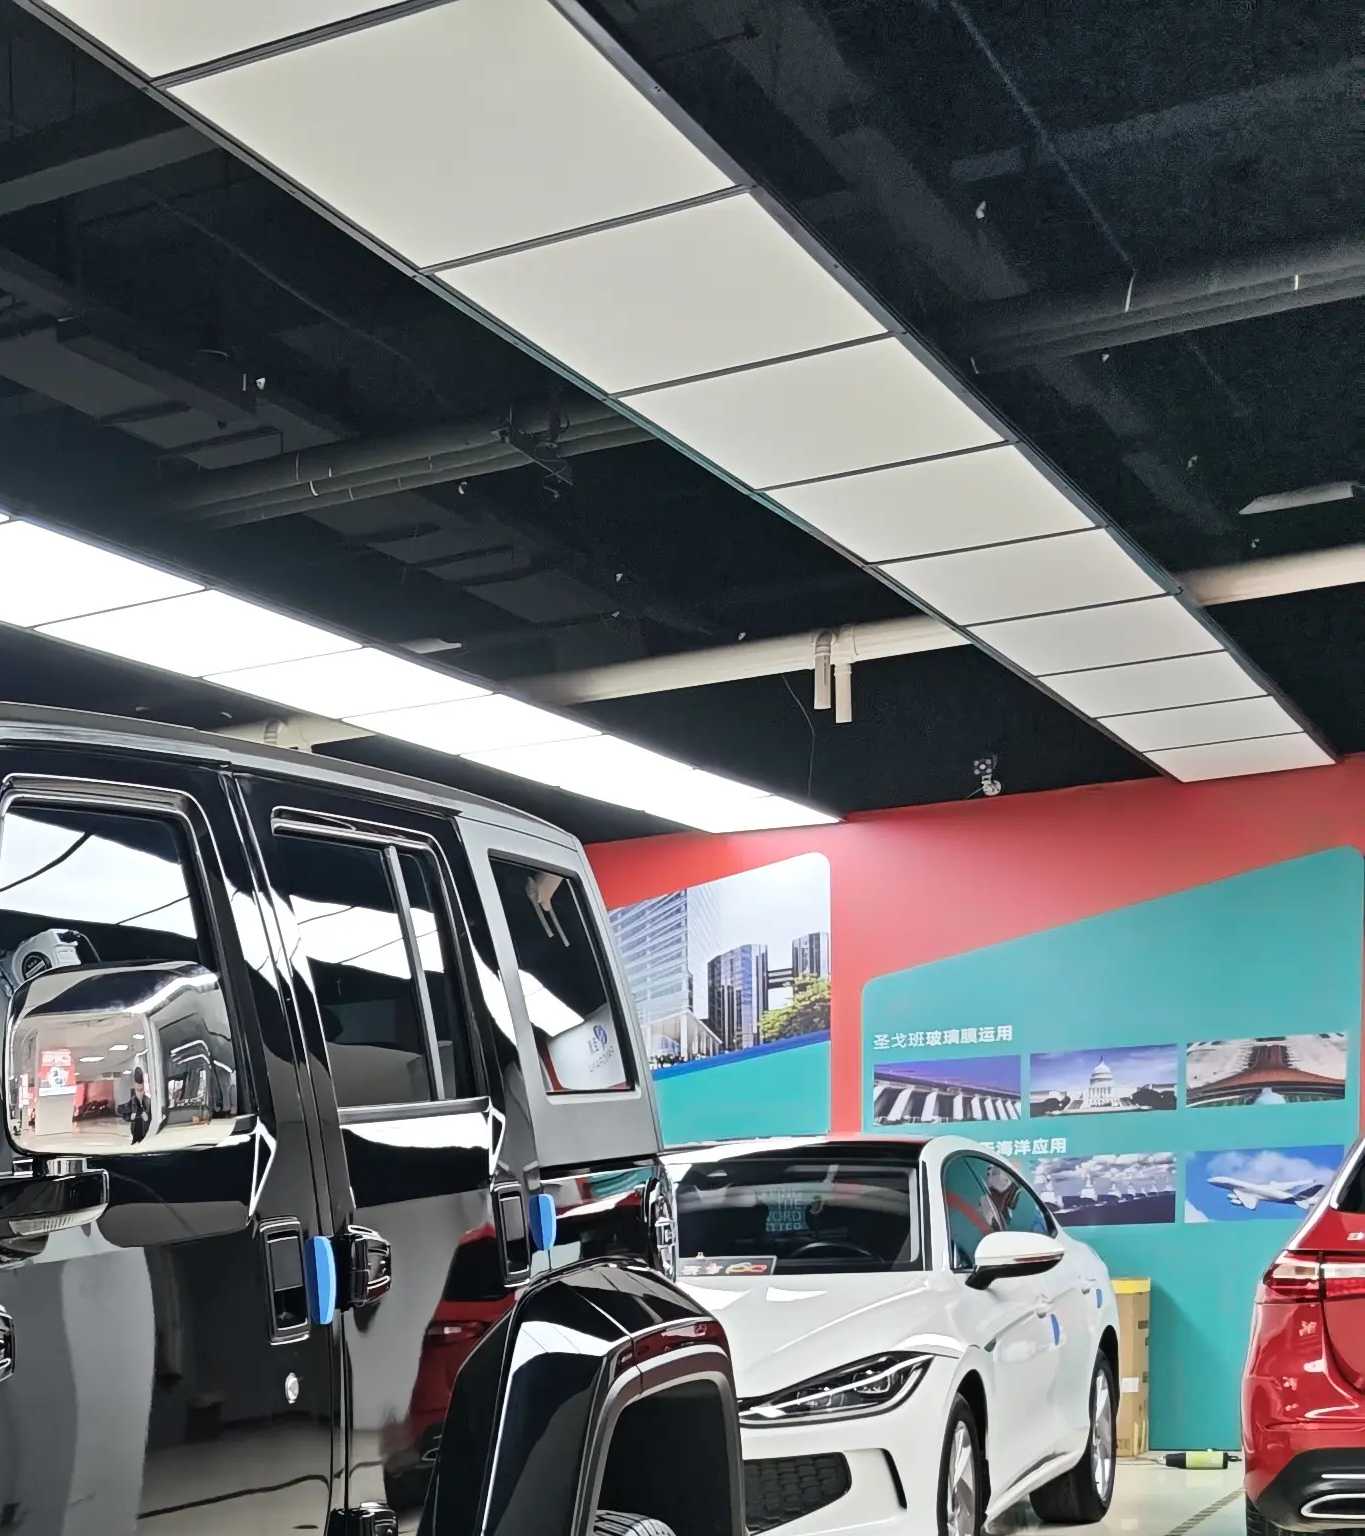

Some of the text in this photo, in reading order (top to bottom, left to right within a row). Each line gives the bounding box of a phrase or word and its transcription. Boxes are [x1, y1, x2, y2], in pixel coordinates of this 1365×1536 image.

[872, 1024, 1014, 1050] 圣戈班玻璃膜运用
